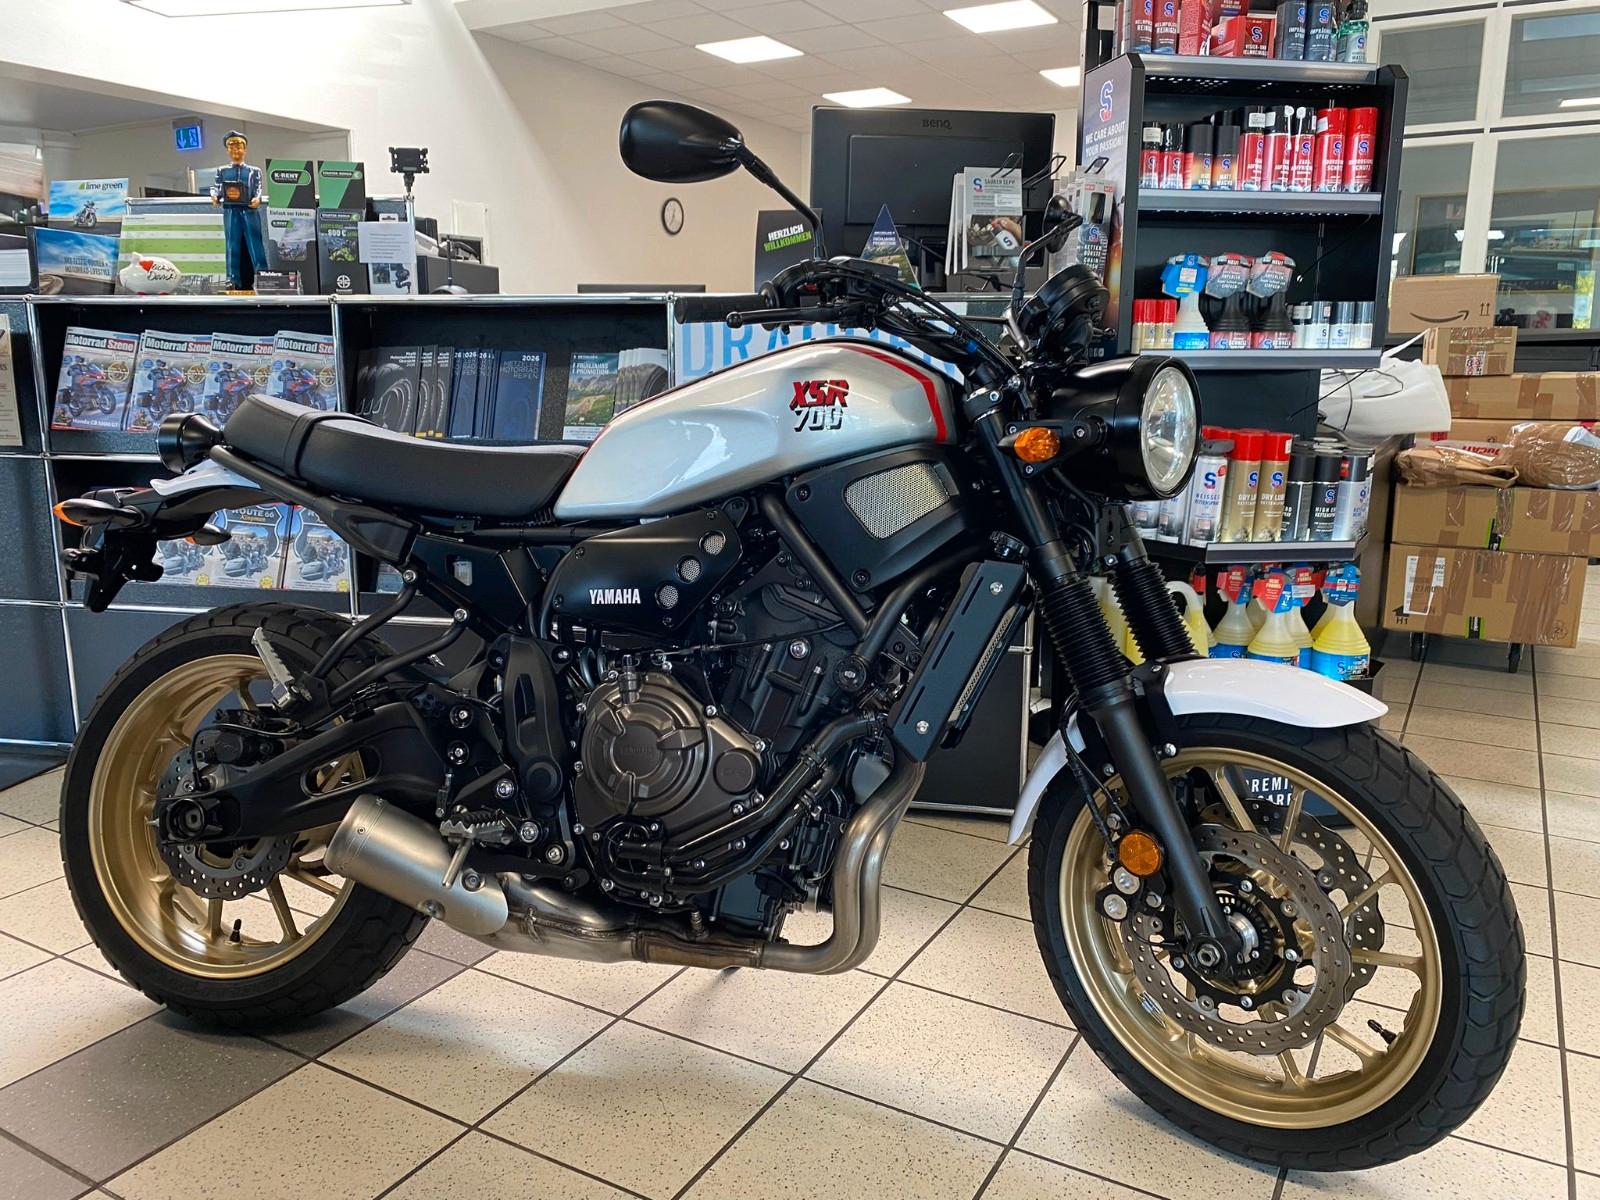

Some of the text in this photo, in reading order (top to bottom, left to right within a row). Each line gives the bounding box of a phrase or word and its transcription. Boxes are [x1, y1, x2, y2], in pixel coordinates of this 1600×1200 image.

[1094, 127, 1107, 141] CARE
[1107, 120, 1126, 136] ABOUT
[86, 182, 123, 191] lime green
[768, 223, 804, 242] HERZLICH
[764, 231, 812, 252] WILLKOMMEN
[67, 334, 134, 352] Motorrad Szene
[146, 337, 187, 351] Motorrad
[213, 339, 273, 354] Motorrad Szen
[277, 338, 334, 354] Motorrad Sze
[522, 354, 540, 362] 2026
[789, 379, 850, 411] XSR
[793, 405, 844, 433] 700
[589, 588, 641, 605] YAMAHA
